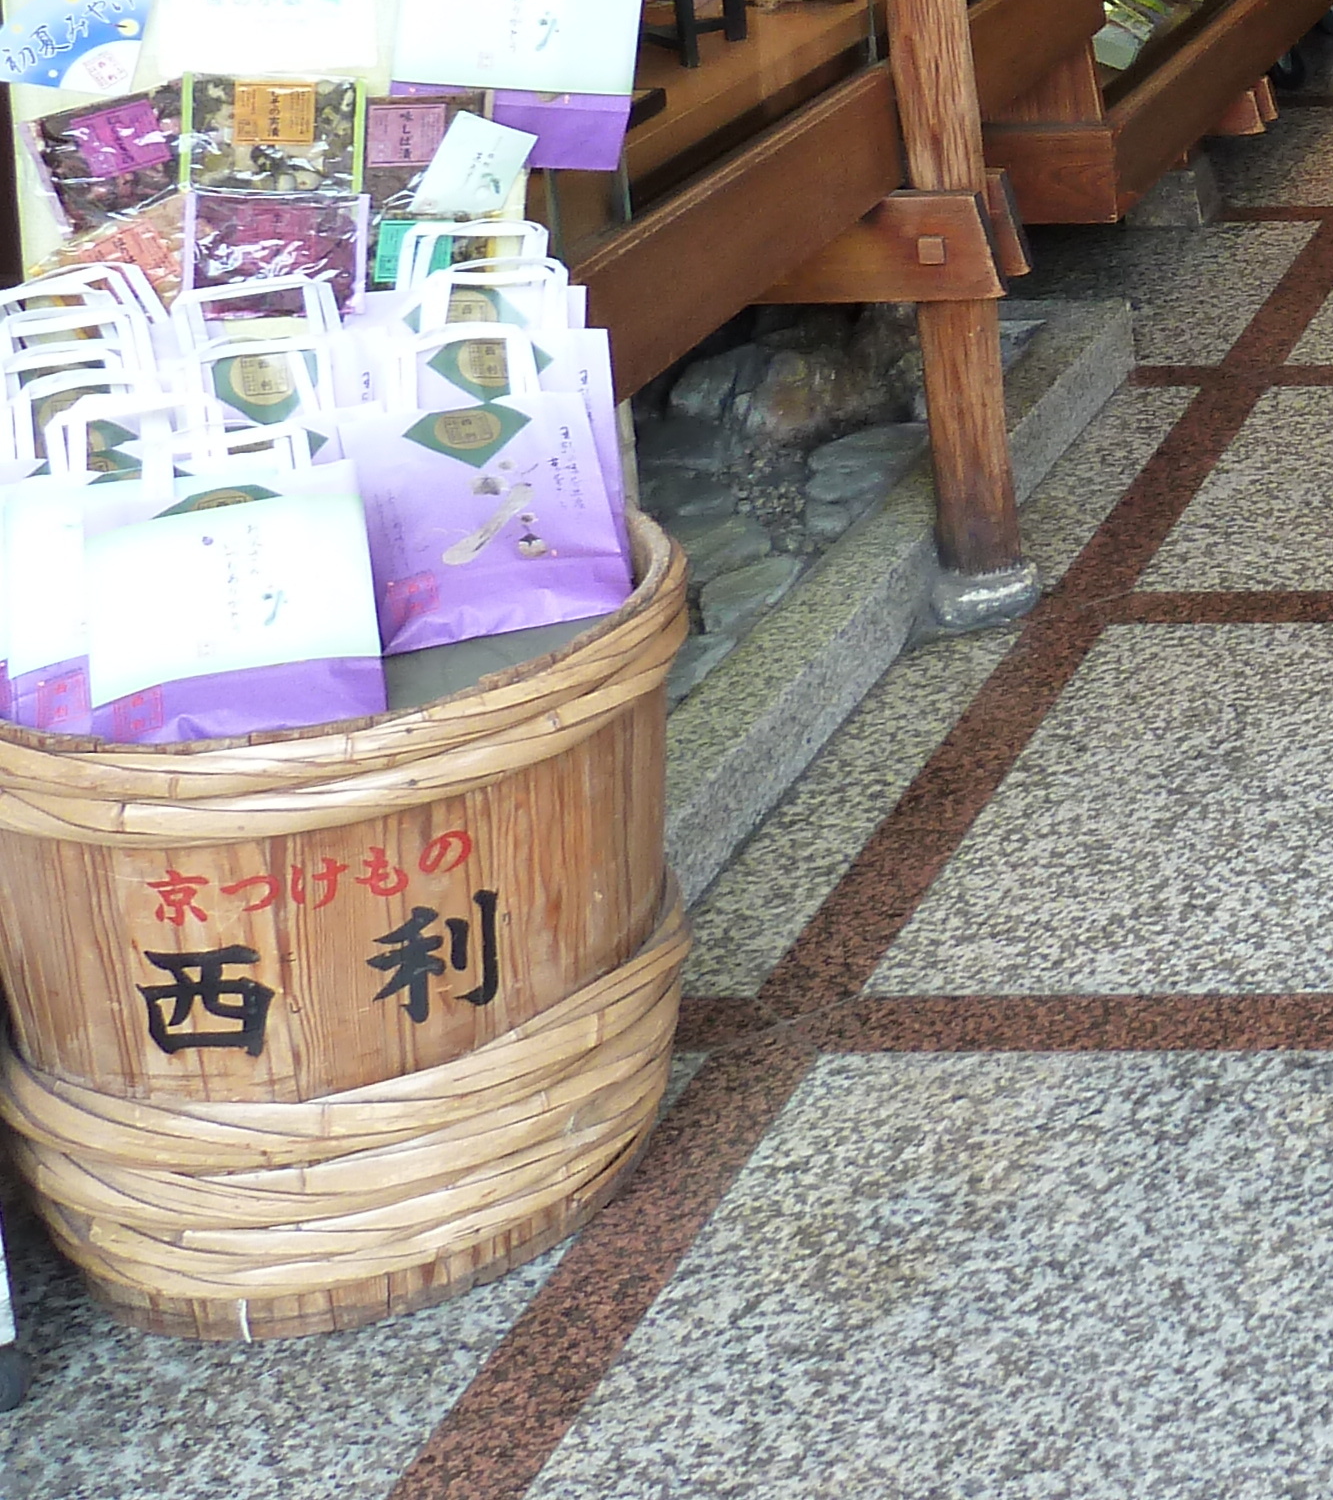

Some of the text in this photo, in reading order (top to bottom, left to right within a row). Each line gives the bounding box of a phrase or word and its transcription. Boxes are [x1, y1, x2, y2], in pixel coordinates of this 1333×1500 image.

[146, 829, 474, 927] 京つけもの
[135, 888, 500, 1058] 西利
